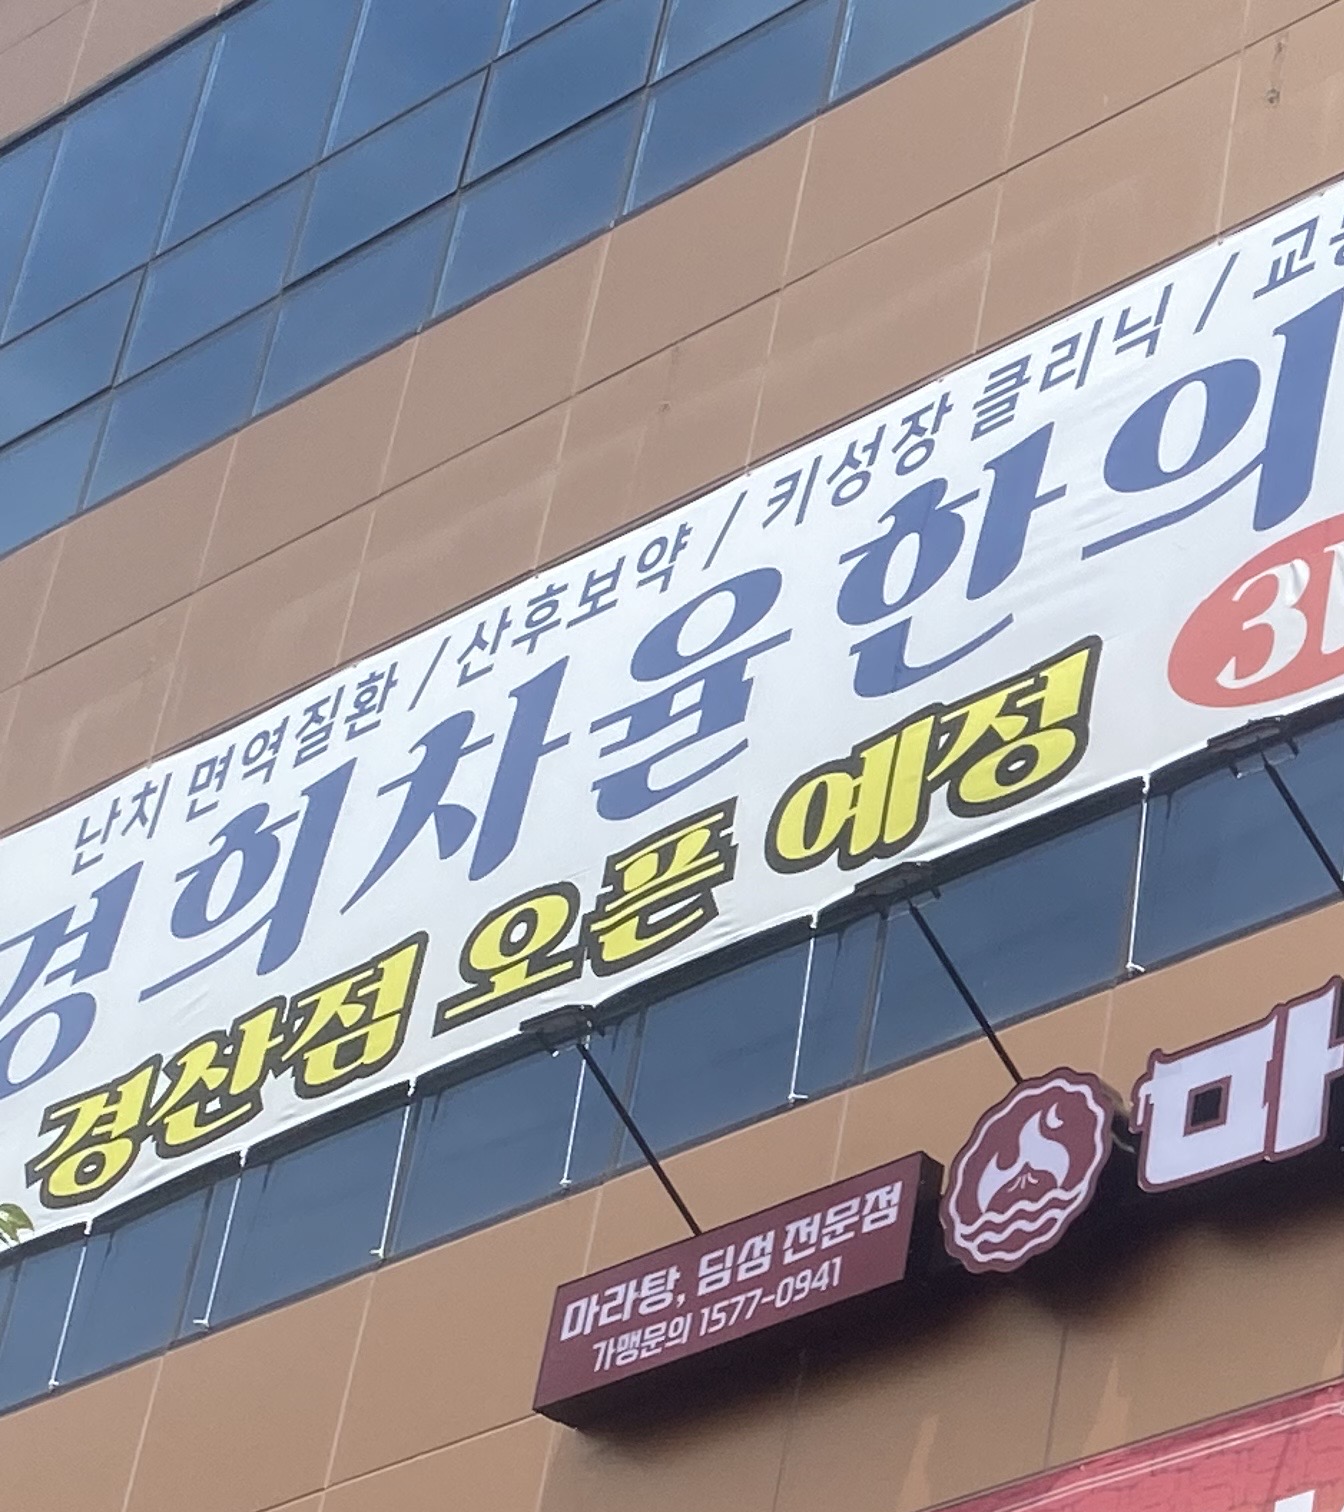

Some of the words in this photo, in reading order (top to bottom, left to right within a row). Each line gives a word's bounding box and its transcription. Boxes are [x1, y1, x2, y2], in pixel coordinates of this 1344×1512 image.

[73, 774, 172, 874] 난치
[186, 662, 398, 821] 면역질환
[457, 522, 692, 686] 산후보약
[763, 392, 953, 529] 키성장
[971, 283, 1174, 441] 클리닉
[28, 935, 427, 1206] 경산점
[434, 797, 737, 1036] 오픈
[766, 637, 1102, 874] 예정
[560, 1257, 686, 1341] 마라탕,
[697, 1230, 775, 1296] 딤섬
[781, 1180, 902, 1258] 전문점
[593, 1311, 693, 1372] 가맹문의
[699, 1256, 842, 1337] 1577-0941
